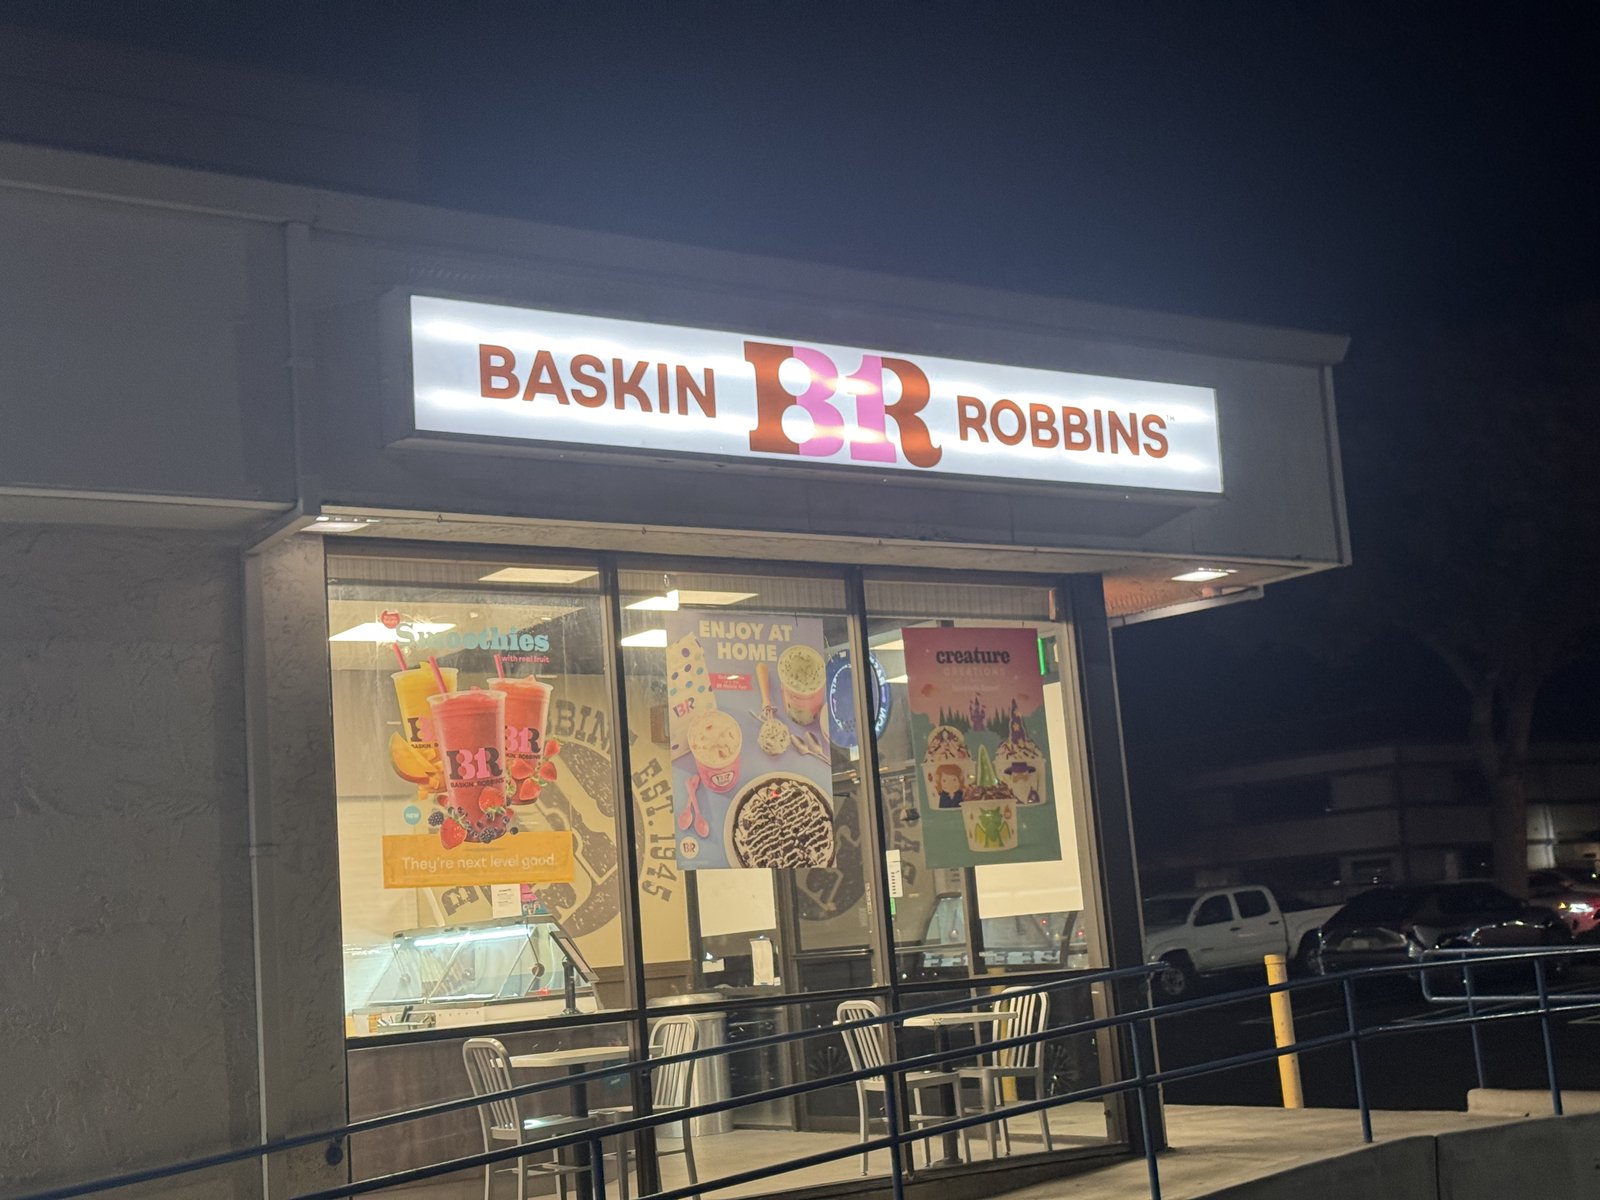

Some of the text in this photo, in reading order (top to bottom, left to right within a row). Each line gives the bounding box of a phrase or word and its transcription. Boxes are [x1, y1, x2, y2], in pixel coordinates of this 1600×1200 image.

[479, 343, 716, 418] BASKIN
[957, 395, 1169, 459] ROBBINS
[699, 619, 793, 641] ENJOY AT
[717, 641, 777, 662] HOME
[936, 646, 1011, 664] creature
[402, 854, 557, 873] They're next level good.
